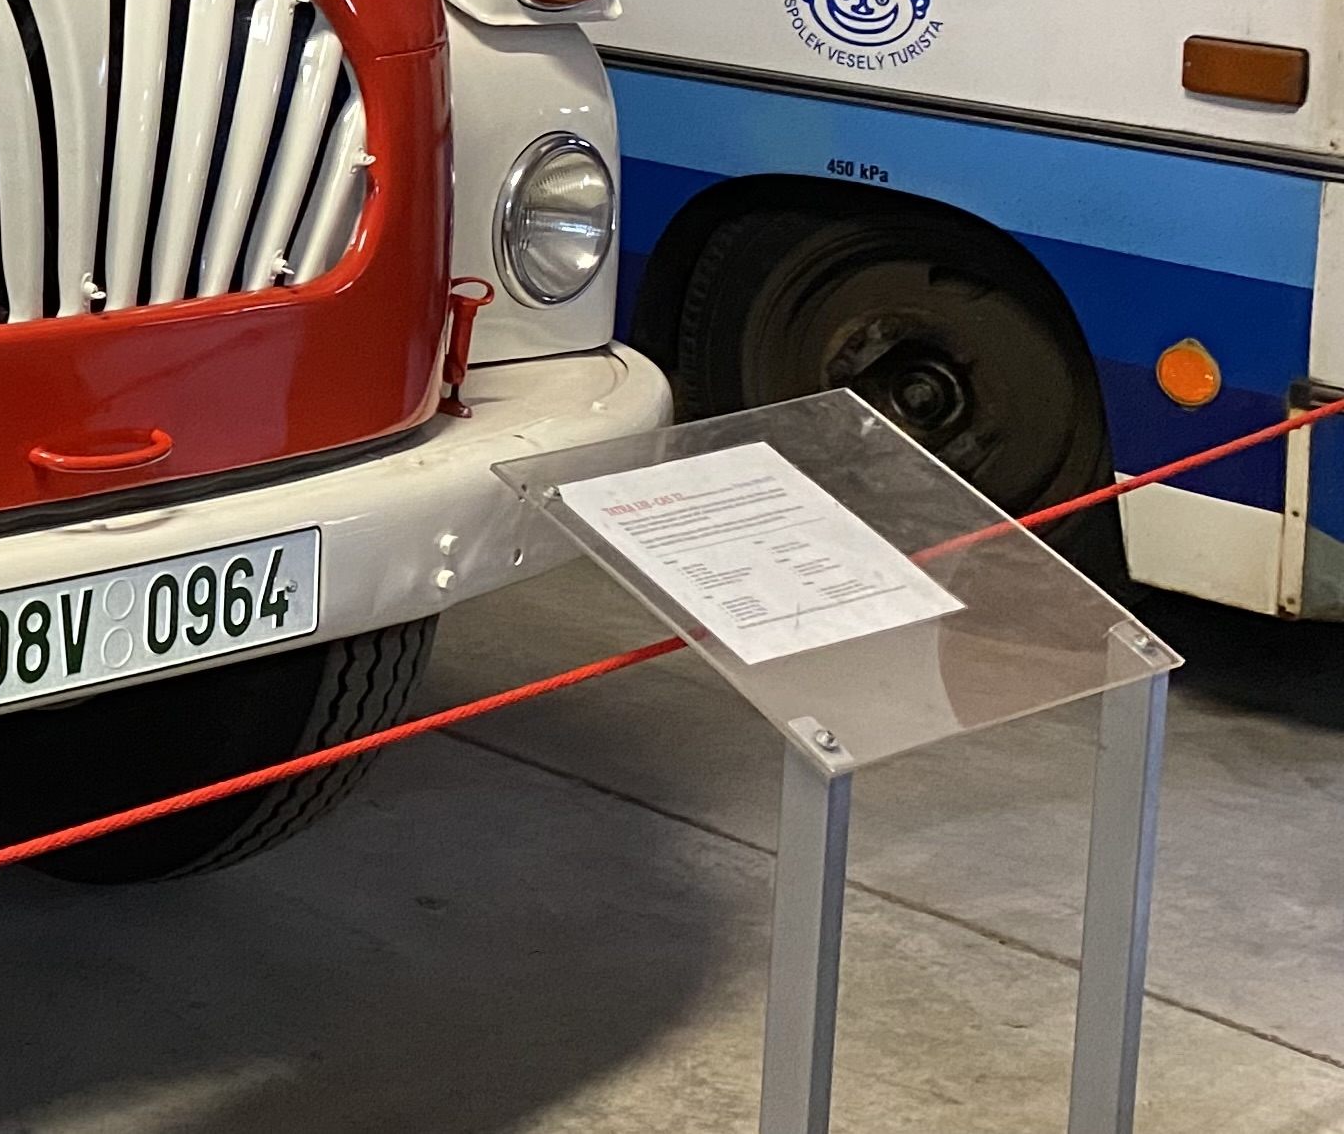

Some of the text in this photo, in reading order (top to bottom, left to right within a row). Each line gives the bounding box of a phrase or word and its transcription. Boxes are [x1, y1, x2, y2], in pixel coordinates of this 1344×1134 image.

[828, 46, 885, 70] VESELÝ
[888, 20, 944, 67] TURISTA
[827, 158, 889, 183] 450 kPa
[146, 546, 290, 655] 0964
